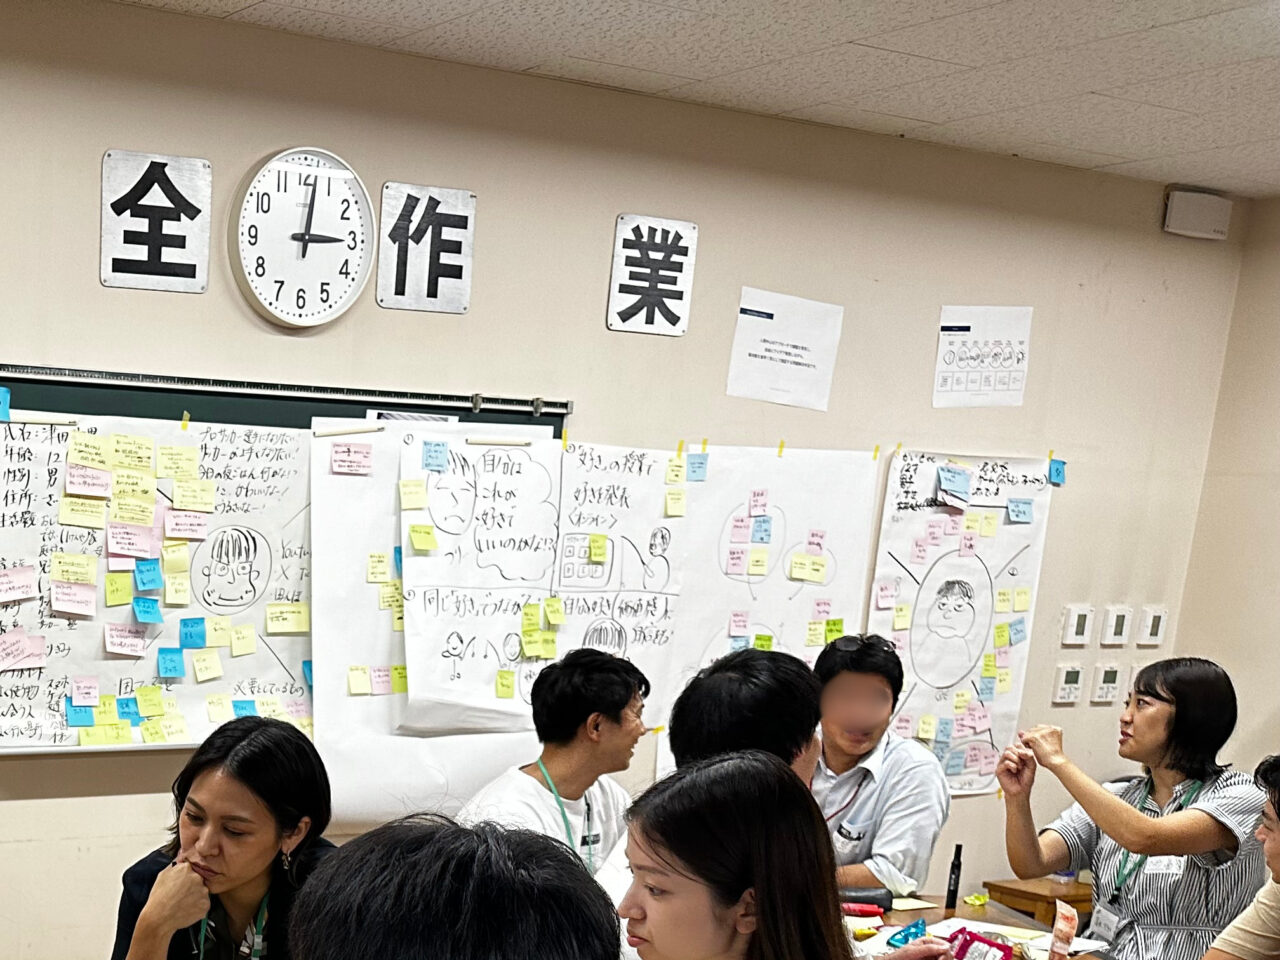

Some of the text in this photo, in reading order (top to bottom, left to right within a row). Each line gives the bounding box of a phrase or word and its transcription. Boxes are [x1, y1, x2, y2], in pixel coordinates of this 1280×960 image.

[256, 192, 271, 214] 10
[340, 198, 351, 221] 2
[110, 161, 202, 278] 全
[248, 224, 259, 246] 9
[347, 230, 357, 251] 3
[388, 194, 471, 299] 作
[255, 256, 266, 278] 8
[338, 258, 351, 280] 4
[618, 224, 690, 327] 業
[274, 280, 285, 302] 7
[296, 288, 306, 309] 6
[319, 282, 331, 303] 5
